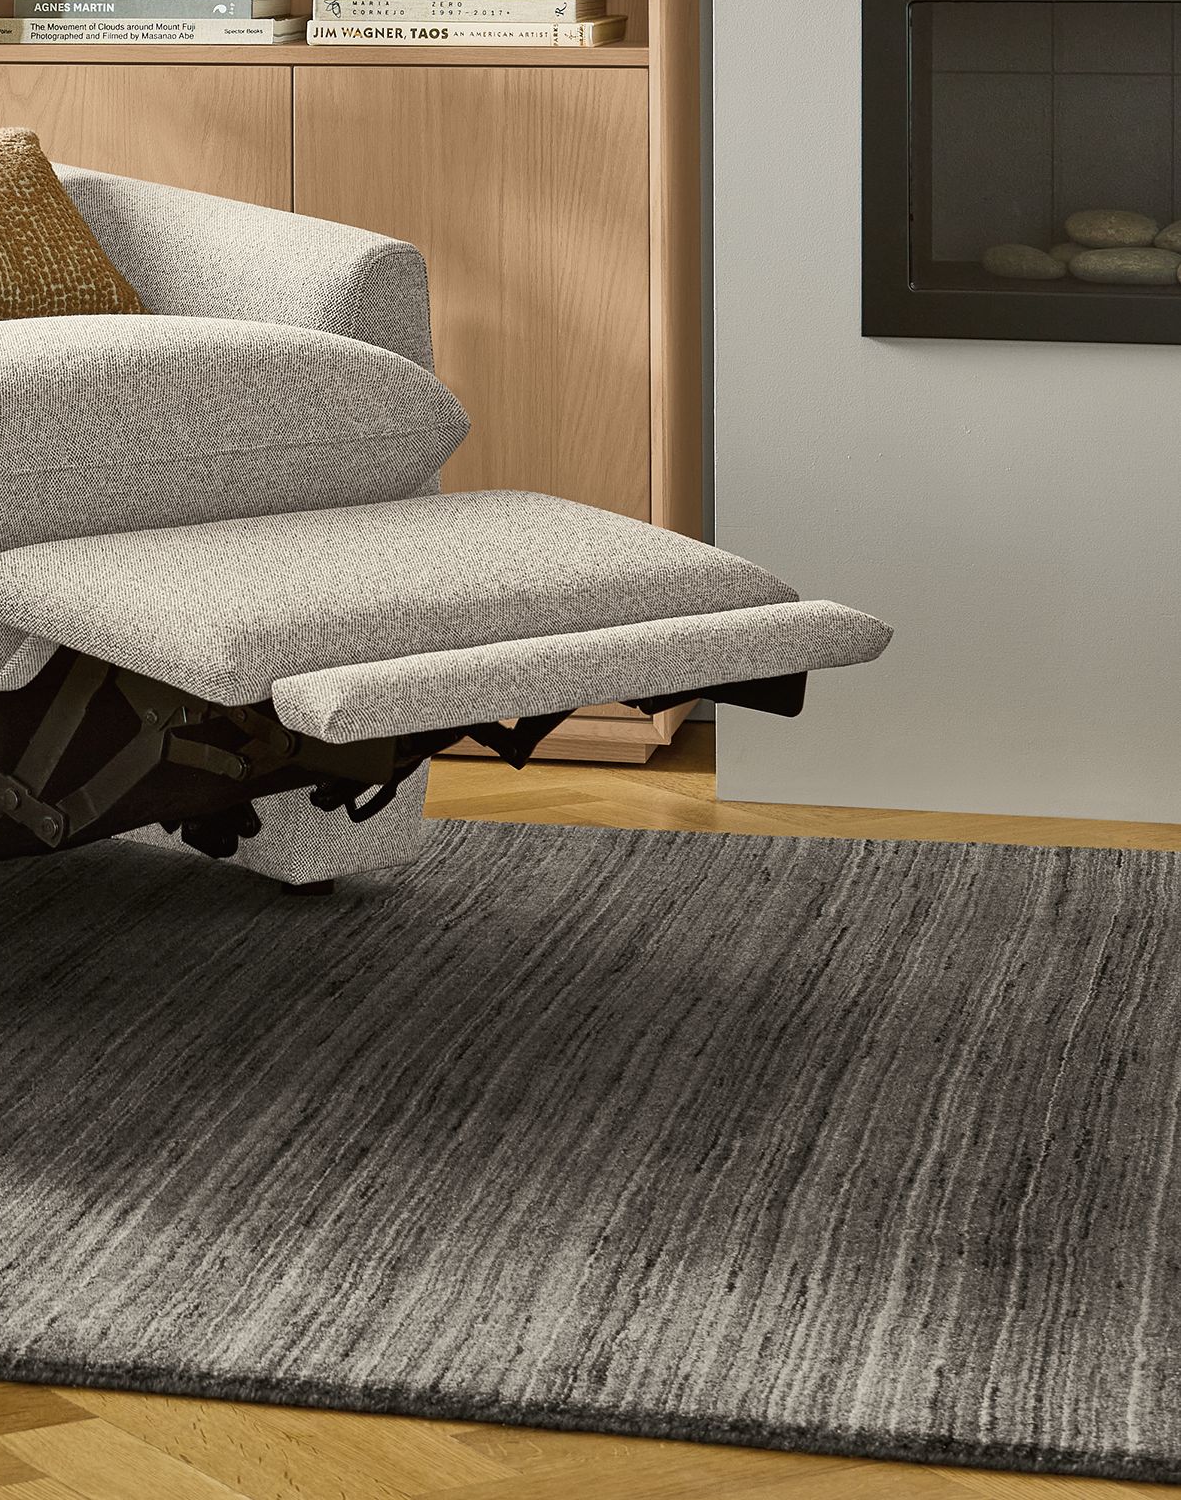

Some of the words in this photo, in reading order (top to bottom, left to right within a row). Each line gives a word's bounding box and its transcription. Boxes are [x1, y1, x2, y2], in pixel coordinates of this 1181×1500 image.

[34, 2, 70, 12] AGNES
[73, 2, 114, 12] MARTIN
[30, 23, 45, 31] The
[47, 23, 87, 31] Movement
[88, 23, 96, 31] of
[98, 23, 124, 31] Clouds
[126, 23, 154, 31] around
[155, 23, 181, 31] Mount
[182, 23, 196, 33] Fuji
[30, 32, 84, 41] Photographed
[130, 32, 140, 41] by
[313, 28, 339, 39] JIM
[341, 27, 407, 41] WAGNER,
[410, 27, 449, 39] TAOS
